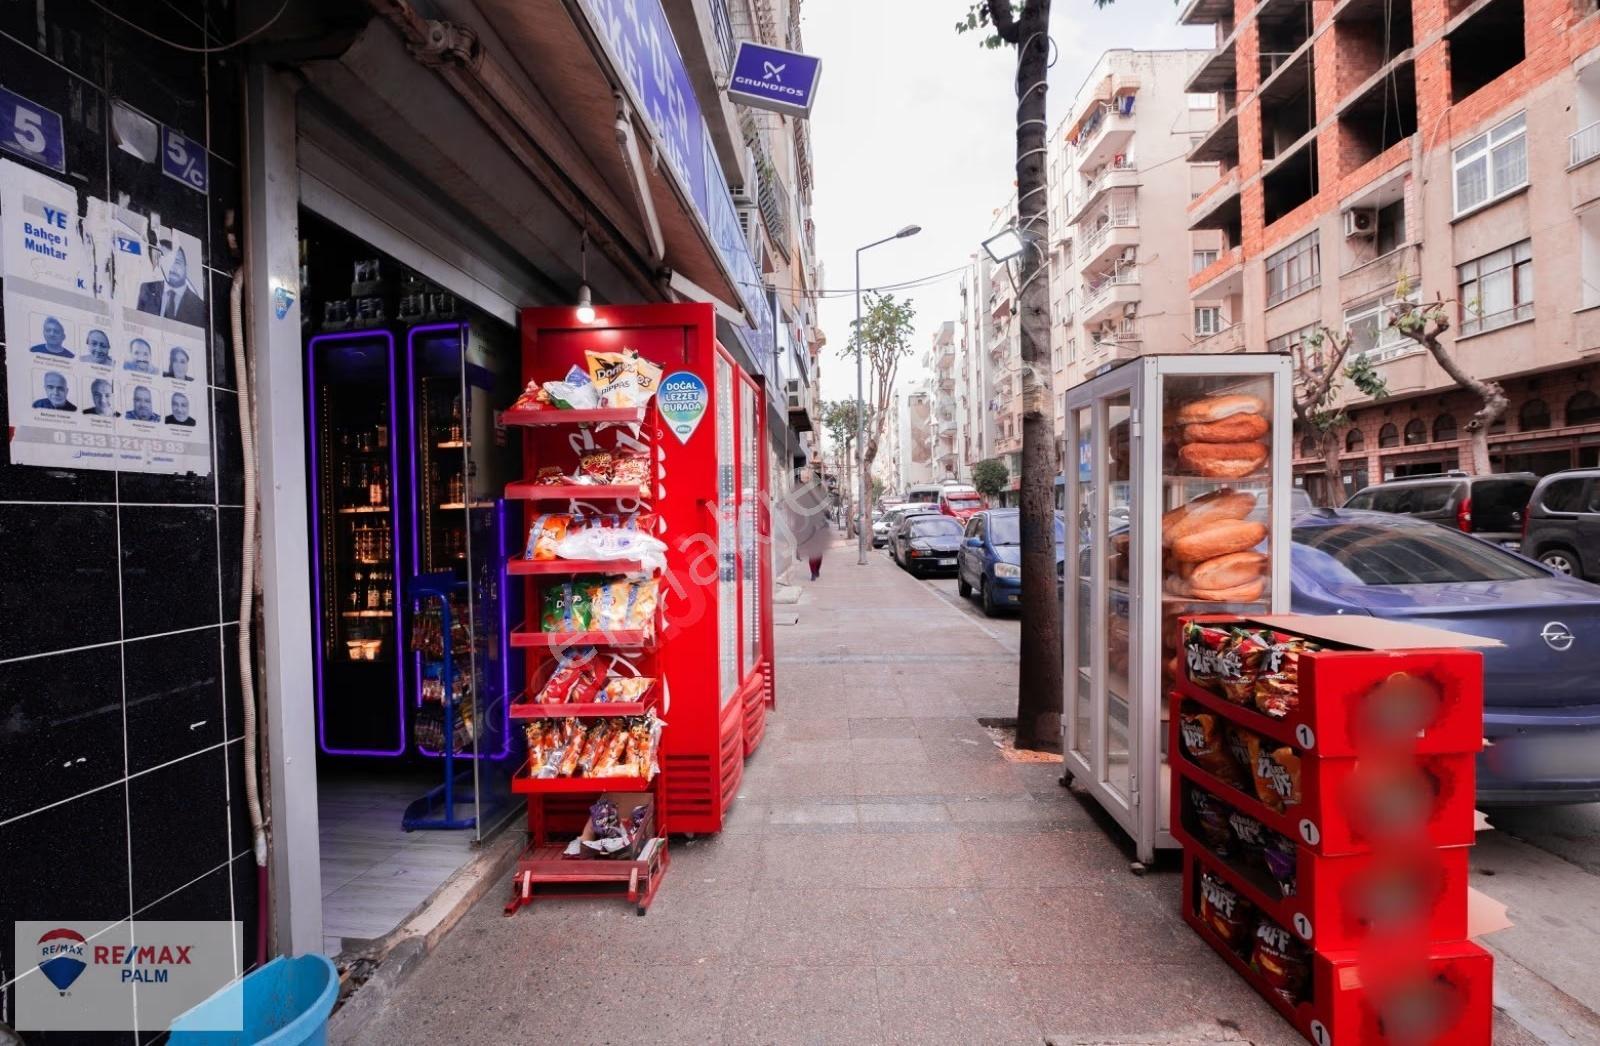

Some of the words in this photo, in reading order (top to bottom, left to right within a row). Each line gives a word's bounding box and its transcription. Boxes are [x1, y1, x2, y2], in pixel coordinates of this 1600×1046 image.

[735, 76, 804, 97] GRUNDFOS
[14, 104, 46, 153] 5
[24, 222, 61, 246] Bahçe
[25, 237, 67, 261] Muhtar
[666, 380, 697, 391] DOĞAL
[665, 391, 699, 401] LEZZET
[664, 401, 701, 412] BURADA
[1300, 727, 1308, 746] 1
[1303, 823, 1312, 841] 1
[1298, 917, 1306, 935] 1
[1315, 1025, 1323, 1044] 1
